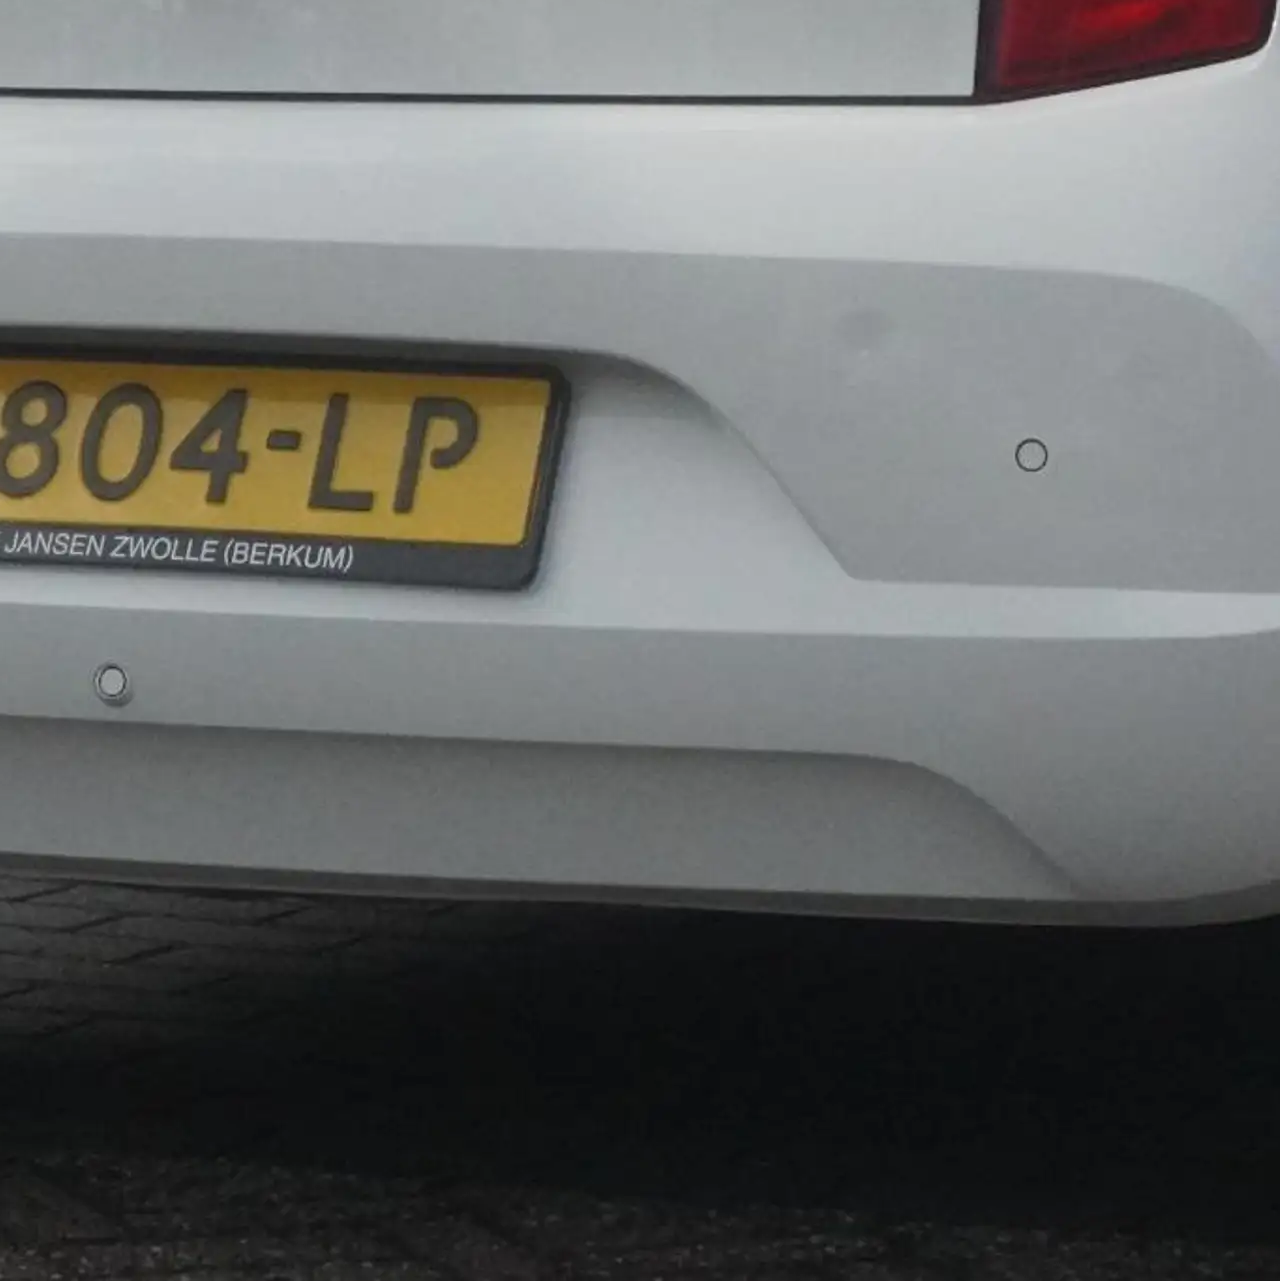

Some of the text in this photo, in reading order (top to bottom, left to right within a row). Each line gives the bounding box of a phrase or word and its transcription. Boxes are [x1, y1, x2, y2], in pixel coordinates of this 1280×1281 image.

[4, 531, 106, 558] JANSEN
[109, 535, 220, 563] ZWOLLE
[223, 539, 355, 573] (BERKUM)
